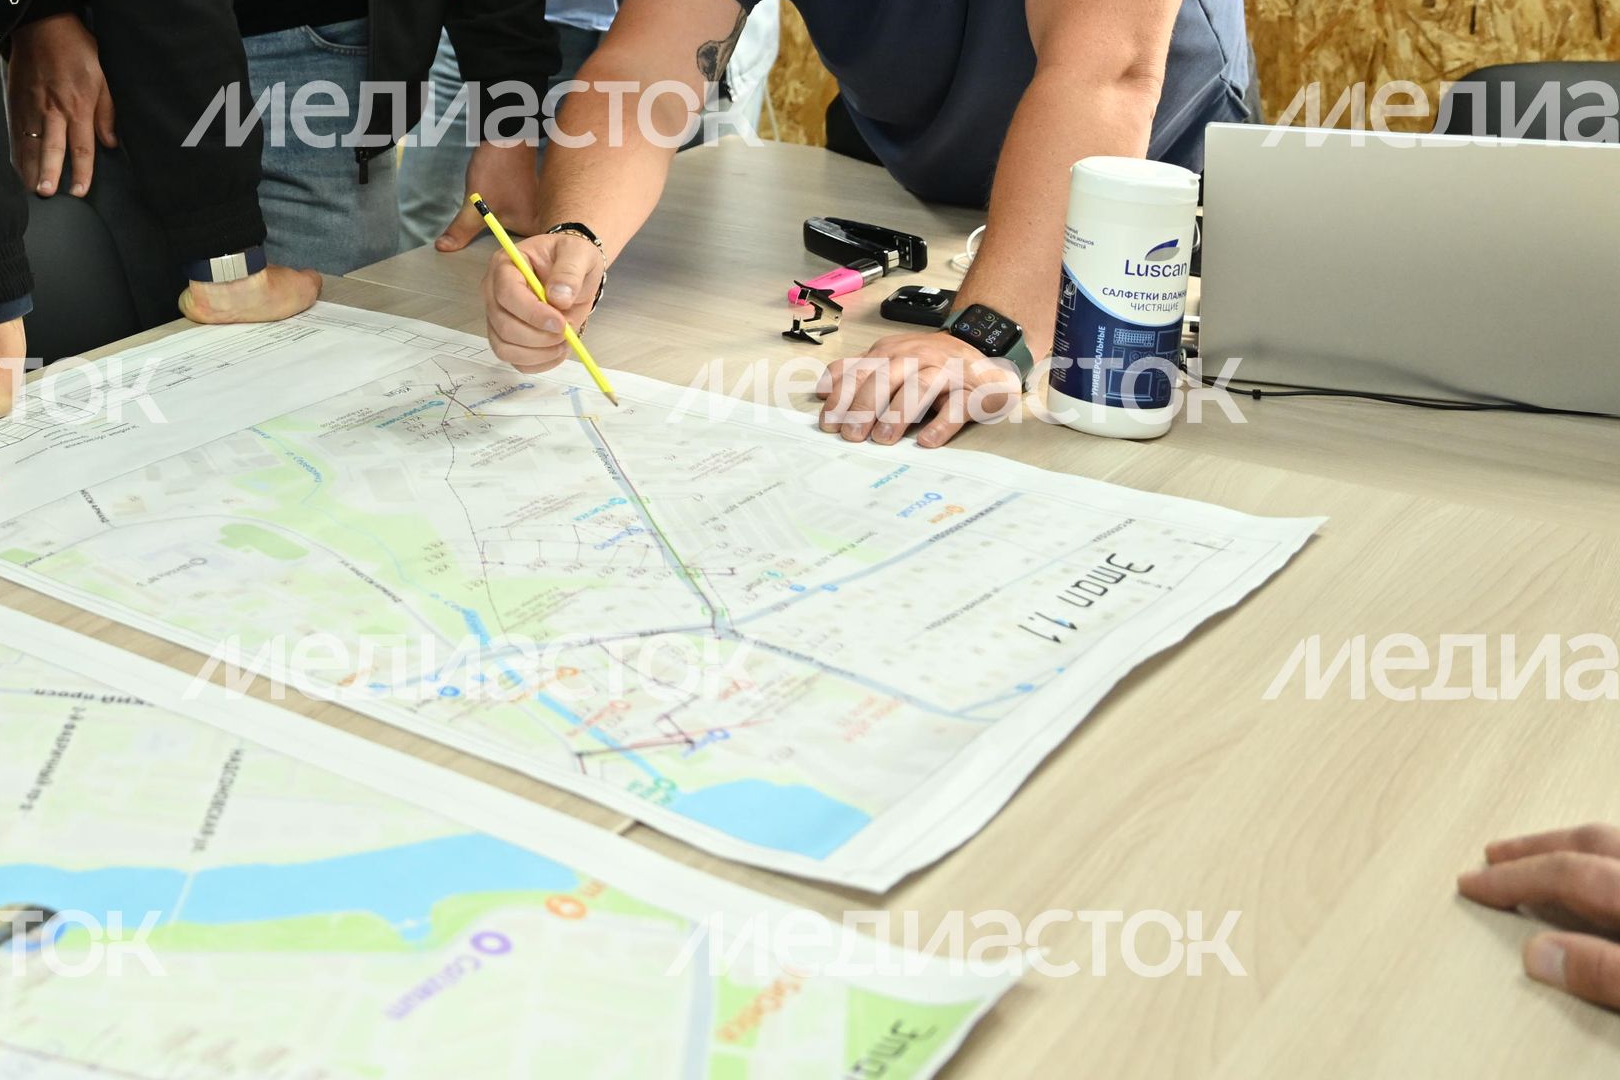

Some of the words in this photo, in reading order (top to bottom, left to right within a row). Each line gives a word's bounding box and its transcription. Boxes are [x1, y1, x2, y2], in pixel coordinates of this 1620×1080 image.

[1124, 259, 1188, 277] Luscan
[1101, 286, 1159, 301] САЛФЕТКИ
[1130, 301, 1179, 313] ЧИСТЯЩИЕ
[984, 328, 1003, 345] 16:50
[1090, 325, 1106, 397] УНИВЕРСАЛЬНЫЕ
[1056, 552, 1155, 609] Этап
[1016, 610, 1078, 645] 1.1
